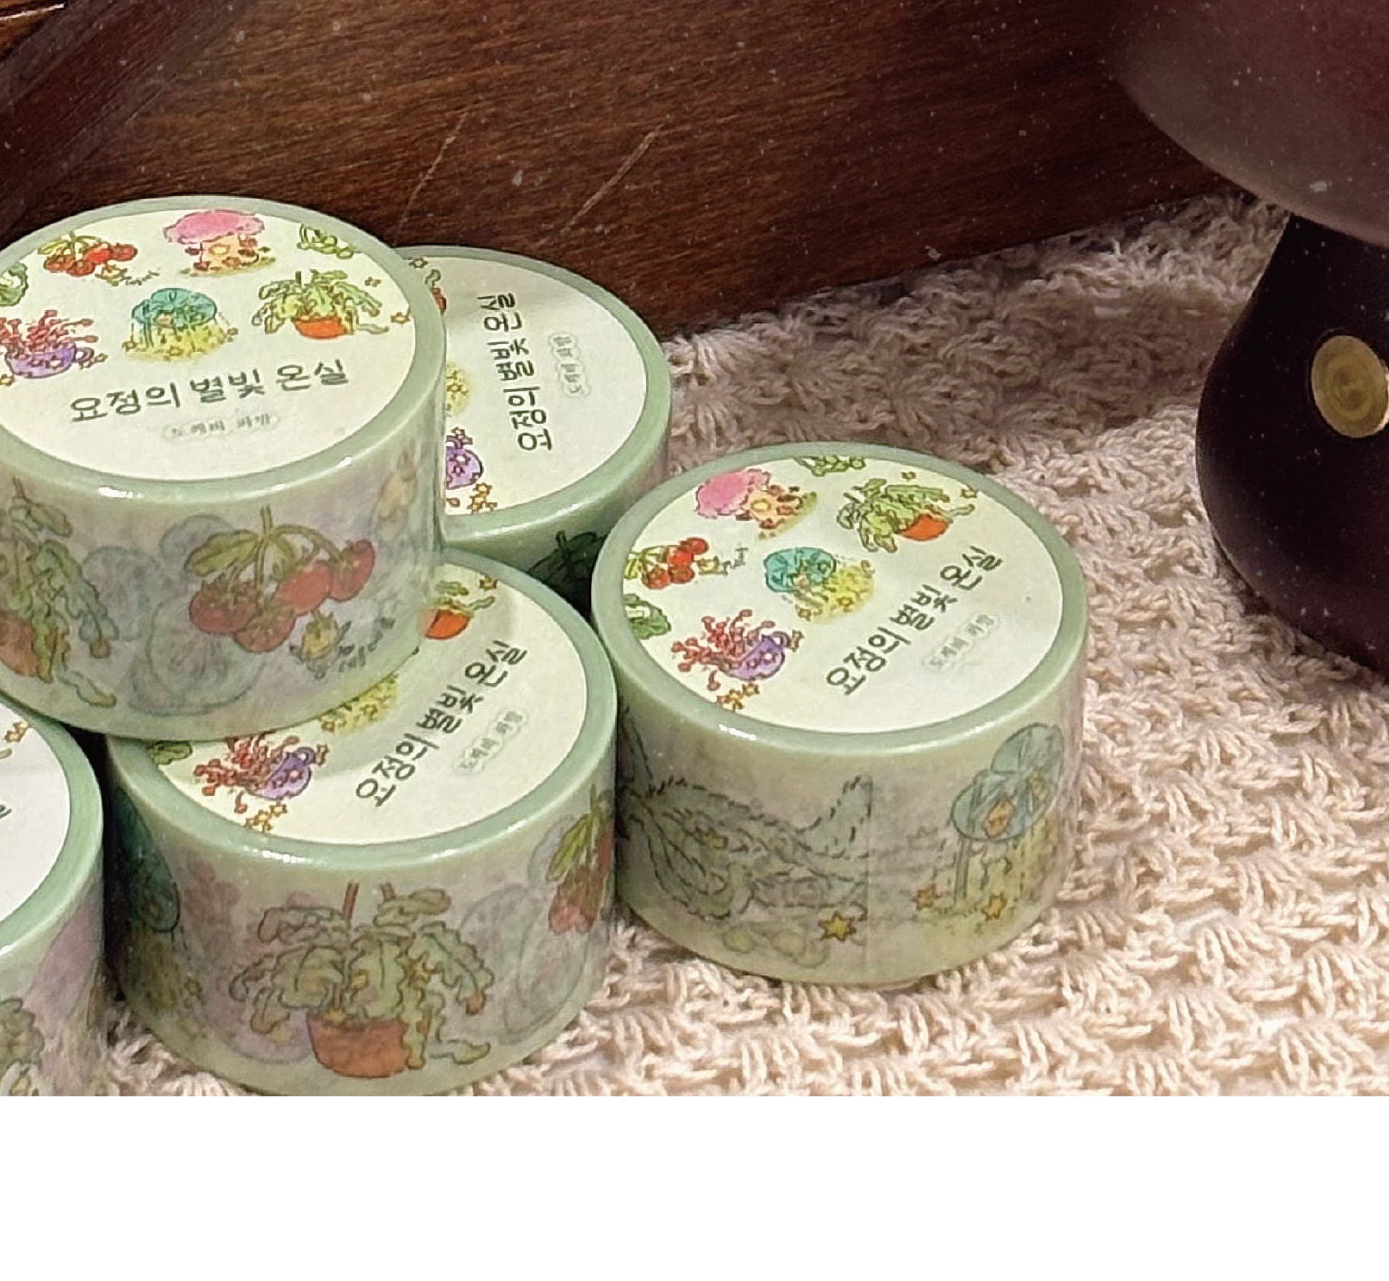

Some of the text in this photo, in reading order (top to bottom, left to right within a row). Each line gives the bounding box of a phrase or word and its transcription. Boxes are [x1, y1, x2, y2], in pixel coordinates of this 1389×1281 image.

[69, 358, 349, 423] 요정의 별빛 온실
[476, 292, 553, 451] 요정의 별빛 온실
[825, 545, 1003, 696] 요정의 별빛 온실
[355, 639, 528, 808] 요정의 별빛 온실
